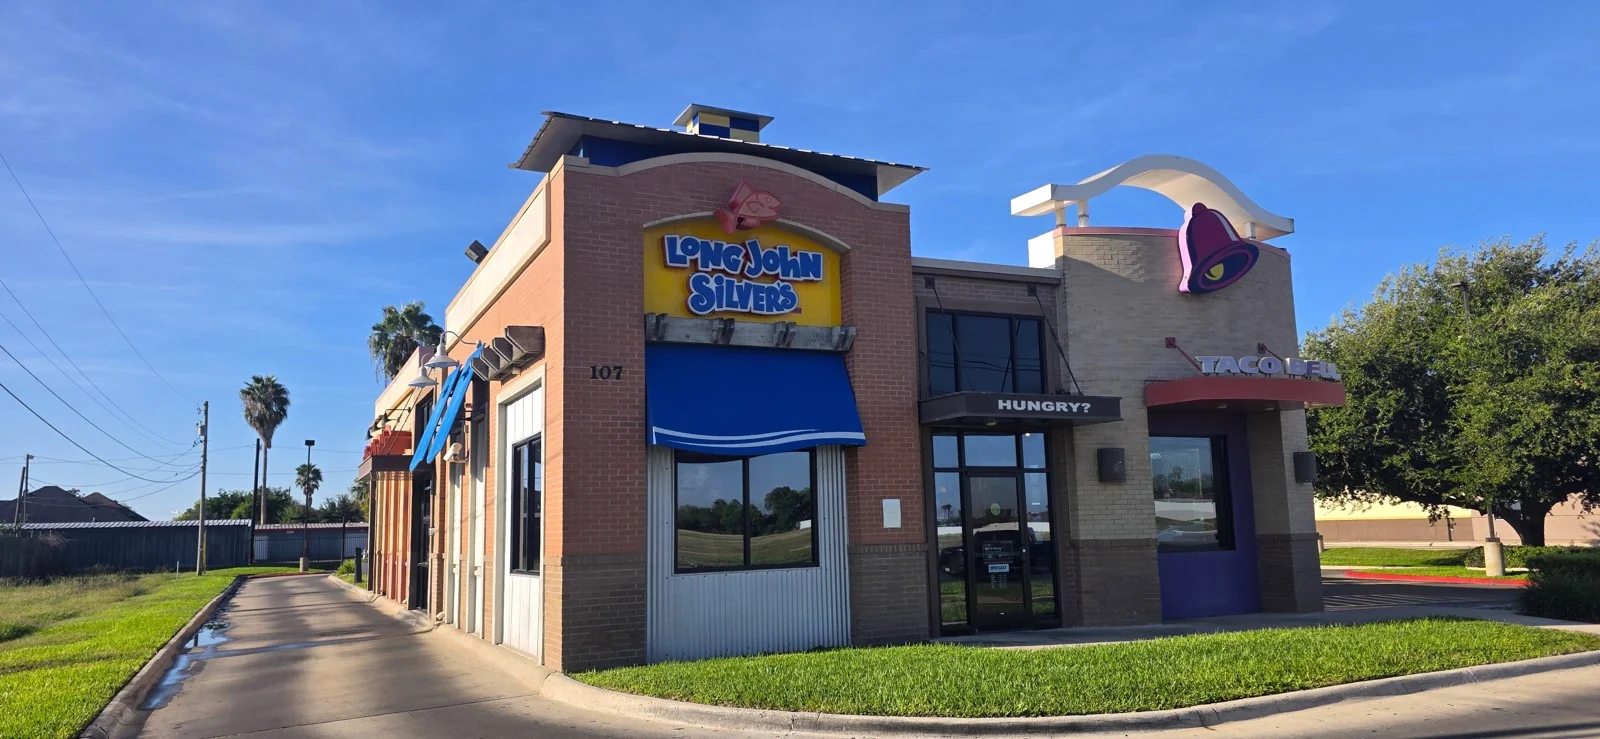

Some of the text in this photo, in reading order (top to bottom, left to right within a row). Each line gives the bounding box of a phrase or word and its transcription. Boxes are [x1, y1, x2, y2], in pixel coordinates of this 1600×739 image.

[664, 235, 745, 274] LONG
[590, 365, 623, 380] 107
[1195, 355, 1341, 380] TACO BELL
[998, 399, 1091, 413] HUNGRY?
